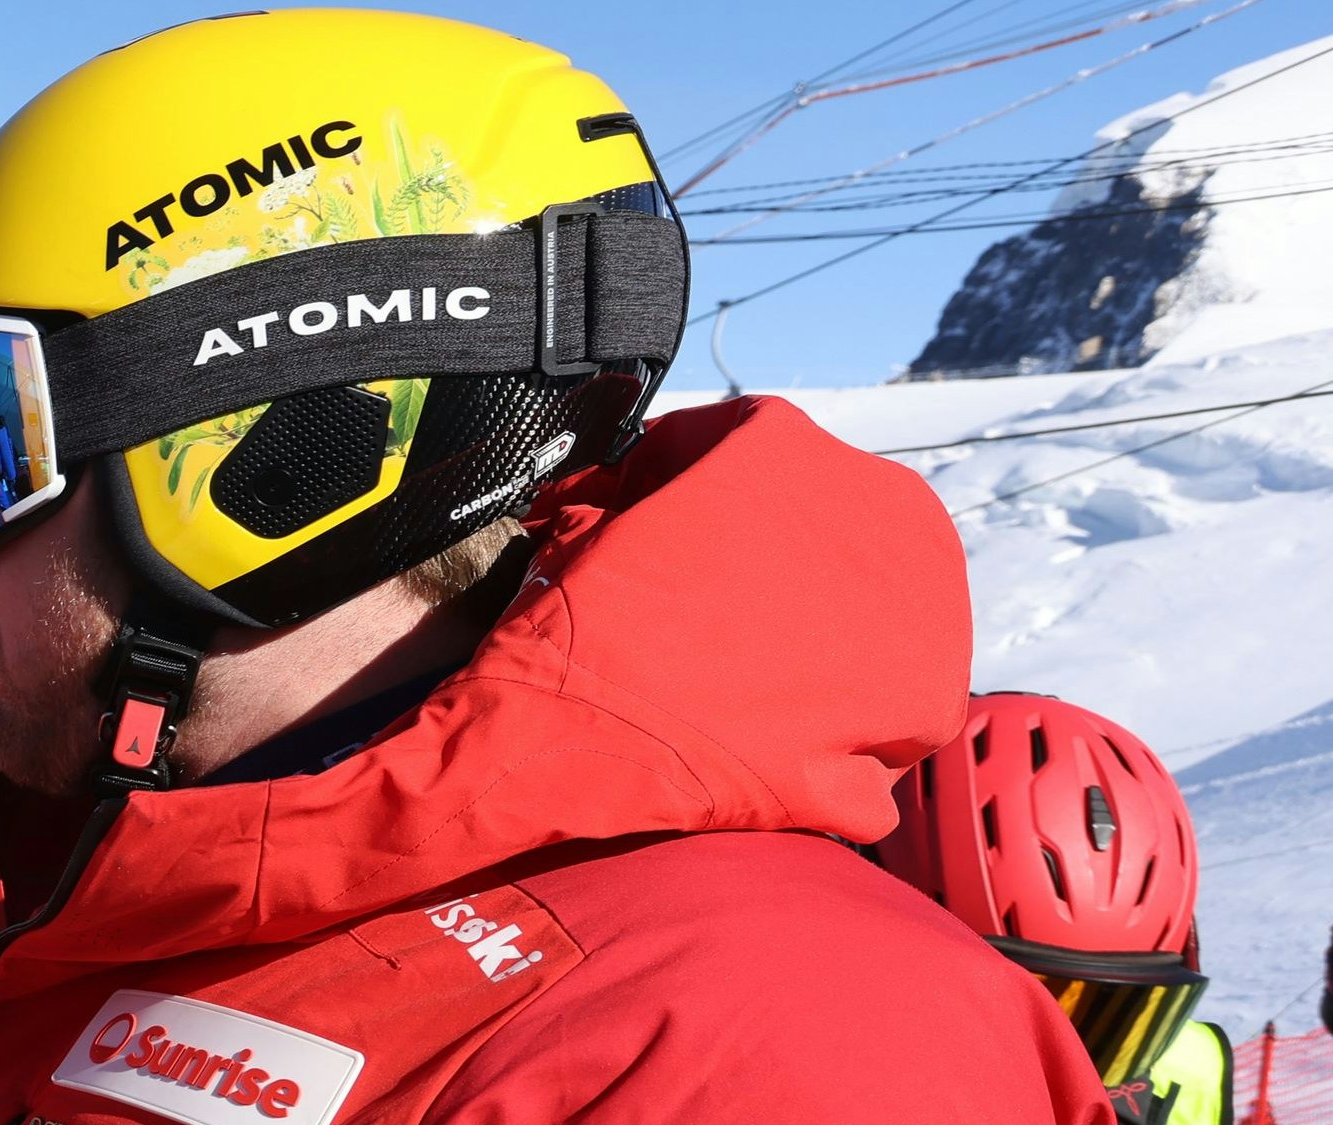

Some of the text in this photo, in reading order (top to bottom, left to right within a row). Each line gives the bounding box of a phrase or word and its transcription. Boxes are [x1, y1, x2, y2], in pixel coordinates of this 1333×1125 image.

[105, 120, 363, 272] ATOMIC
[193, 287, 491, 366] ATOMIC
[546, 231, 555, 348] ENGINEERED IN AUSTRIA
[450, 482, 513, 520] CARBON
[124, 1025, 301, 1119] Sunrise
